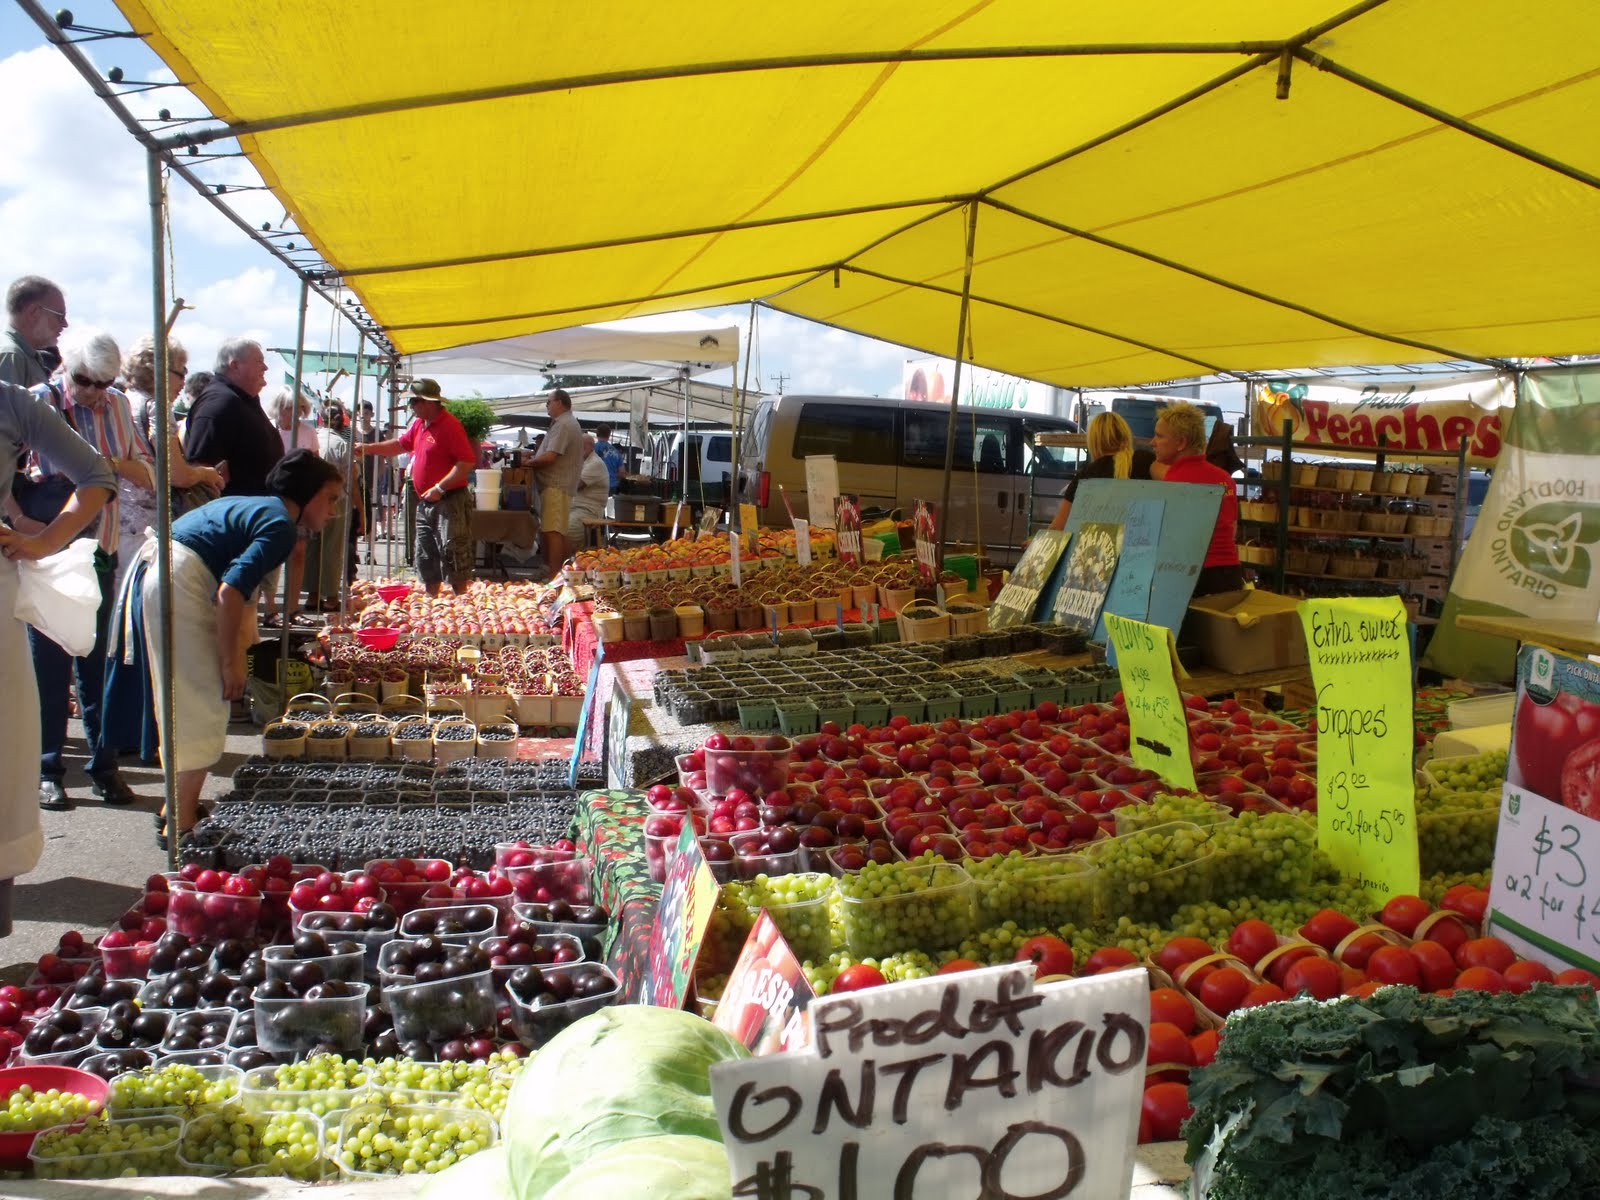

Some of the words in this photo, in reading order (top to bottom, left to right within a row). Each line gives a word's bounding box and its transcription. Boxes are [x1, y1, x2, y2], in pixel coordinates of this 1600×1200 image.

[1352, 385, 1416, 413] Fresh
[1302, 399, 1502, 458] Peaches
[1496, 479, 1584, 533] FOODLAND
[1491, 538, 1557, 600] ONTARIO
[1109, 615, 1154, 653] PLUMS
[1312, 609, 1353, 648] Extra
[1361, 610, 1402, 642] sweet
[1566, 663, 1583, 678] PICK
[1317, 683, 1388, 767] Grapes
[1346, 811, 1355, 835] 2
[1355, 809, 1371, 845] for
[1532, 815, 1587, 888] $3
[1520, 875, 1531, 901] 2
[1539, 881, 1565, 921] for
[742, 968, 795, 1019] RESH
[815, 983, 970, 1059] Prod
[969, 970, 1046, 1037] of
[728, 1012, 1147, 1144] ONTARIO
